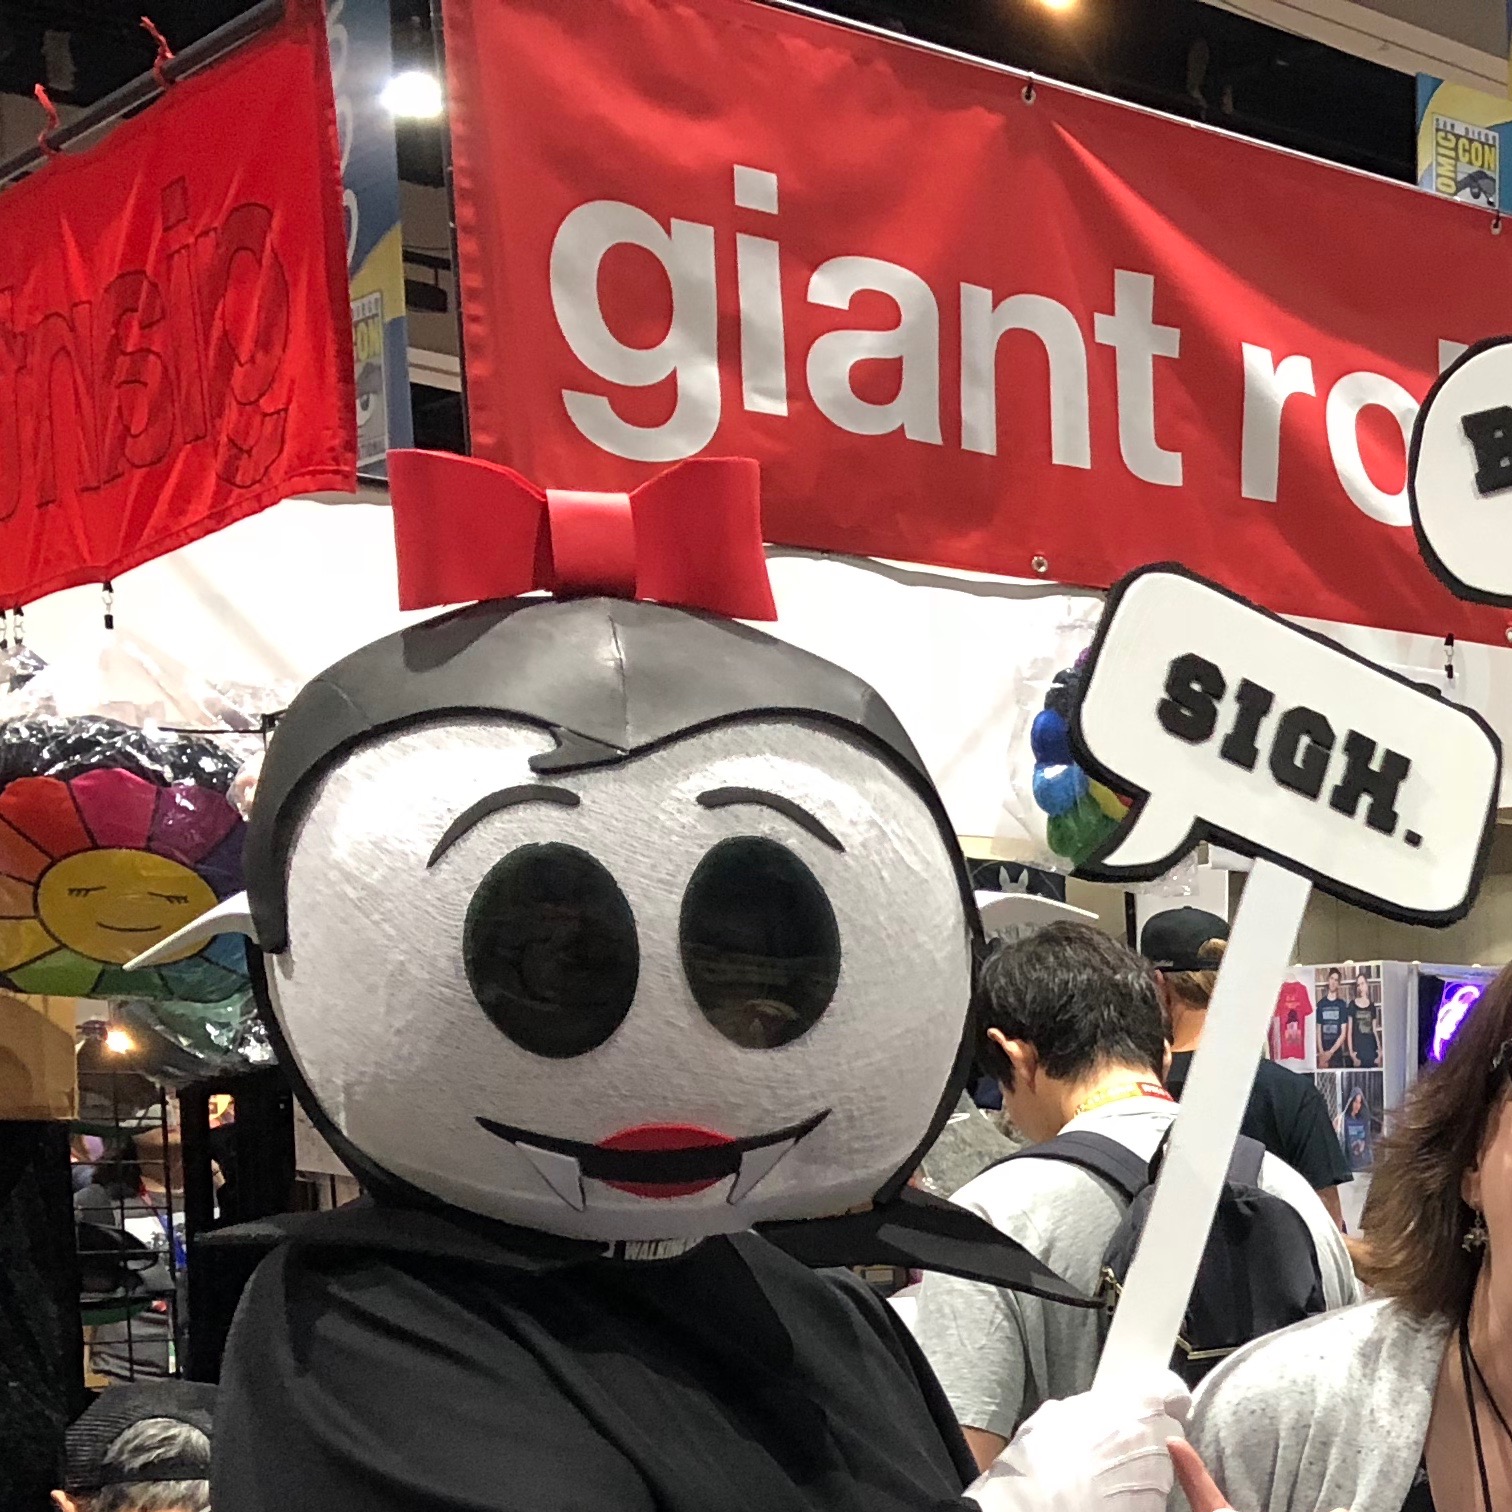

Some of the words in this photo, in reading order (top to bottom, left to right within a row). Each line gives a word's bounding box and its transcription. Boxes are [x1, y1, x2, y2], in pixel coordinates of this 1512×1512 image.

[1458, 137, 1496, 172] CON
[550, 164, 1183, 487] giant
[1240, 339, 1469, 527] ro
[1156, 652, 1424, 849] SIGH.
